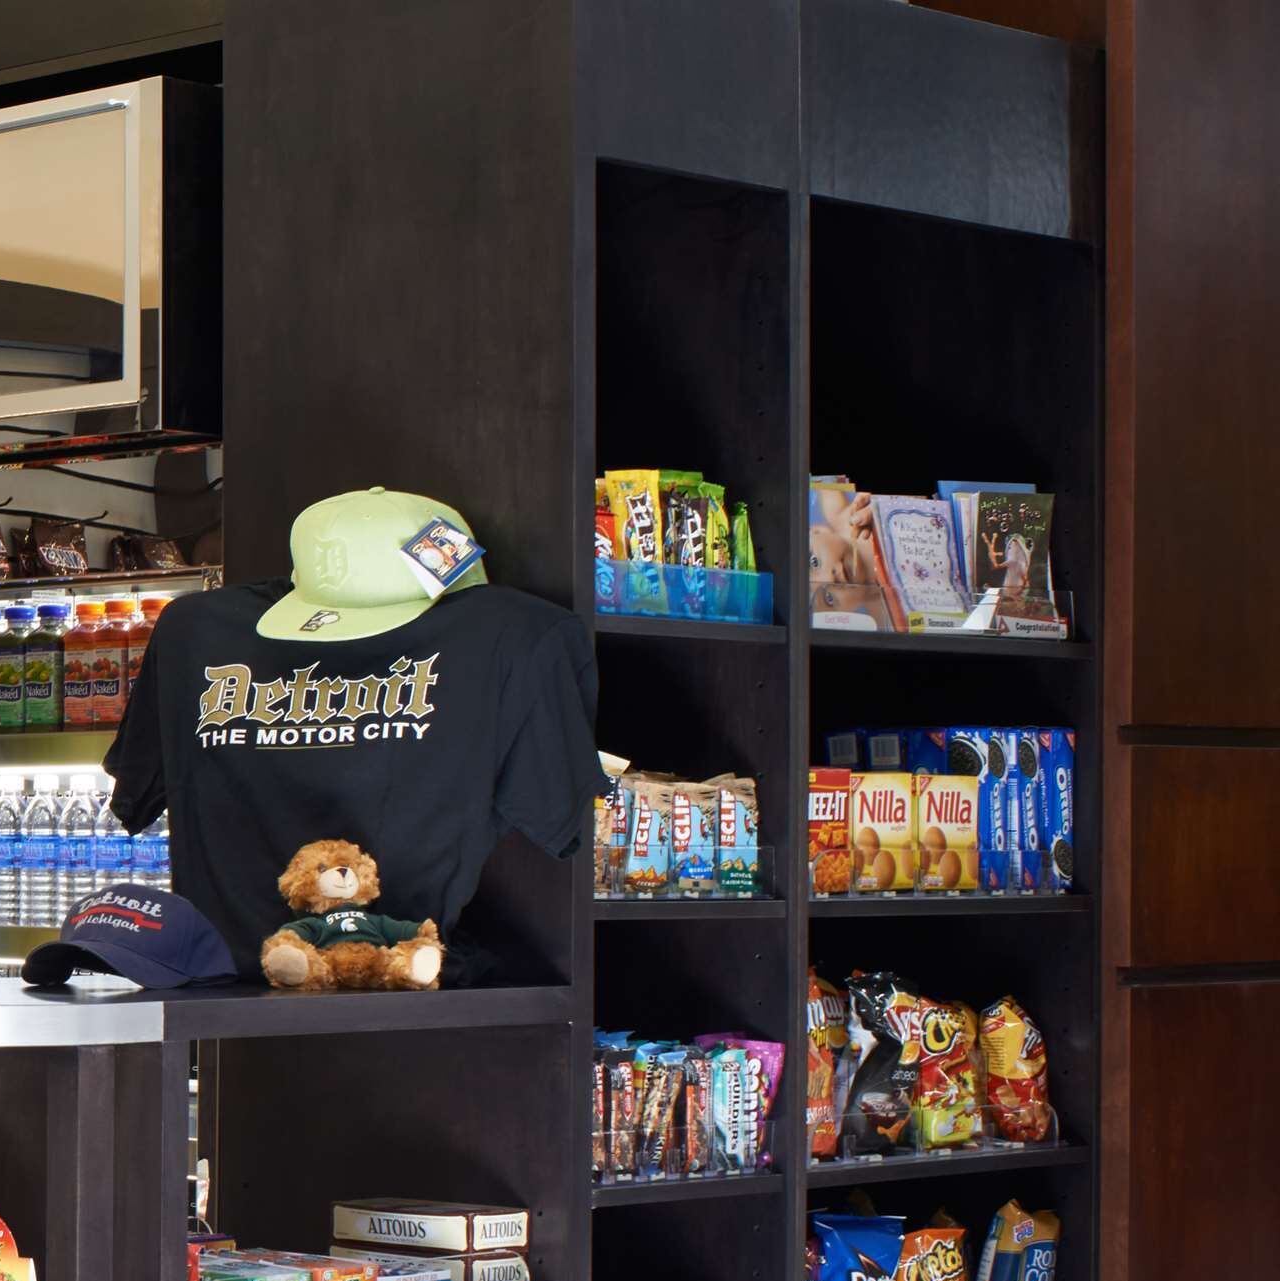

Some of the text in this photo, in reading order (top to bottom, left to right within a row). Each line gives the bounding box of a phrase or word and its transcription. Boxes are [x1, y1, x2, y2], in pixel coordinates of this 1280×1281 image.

[195, 652, 439, 735] Detroit
[199, 722, 431, 748] THE MOTOR CITY
[635, 794, 652, 843] CLIF
[672, 790, 691, 840] CLIF
[720, 788, 736, 834] CLIF
[859, 789, 906, 826] Nilla
[926, 790, 973, 827] Nilla
[990, 782, 1006, 851] OREO
[1024, 782, 1039, 851] OREO
[1055, 766, 1071, 836] OREO
[79, 890, 163, 922] Detroit
[368, 1215, 427, 1240] ALTOIDS
[480, 1219, 523, 1241] ALTOIDS
